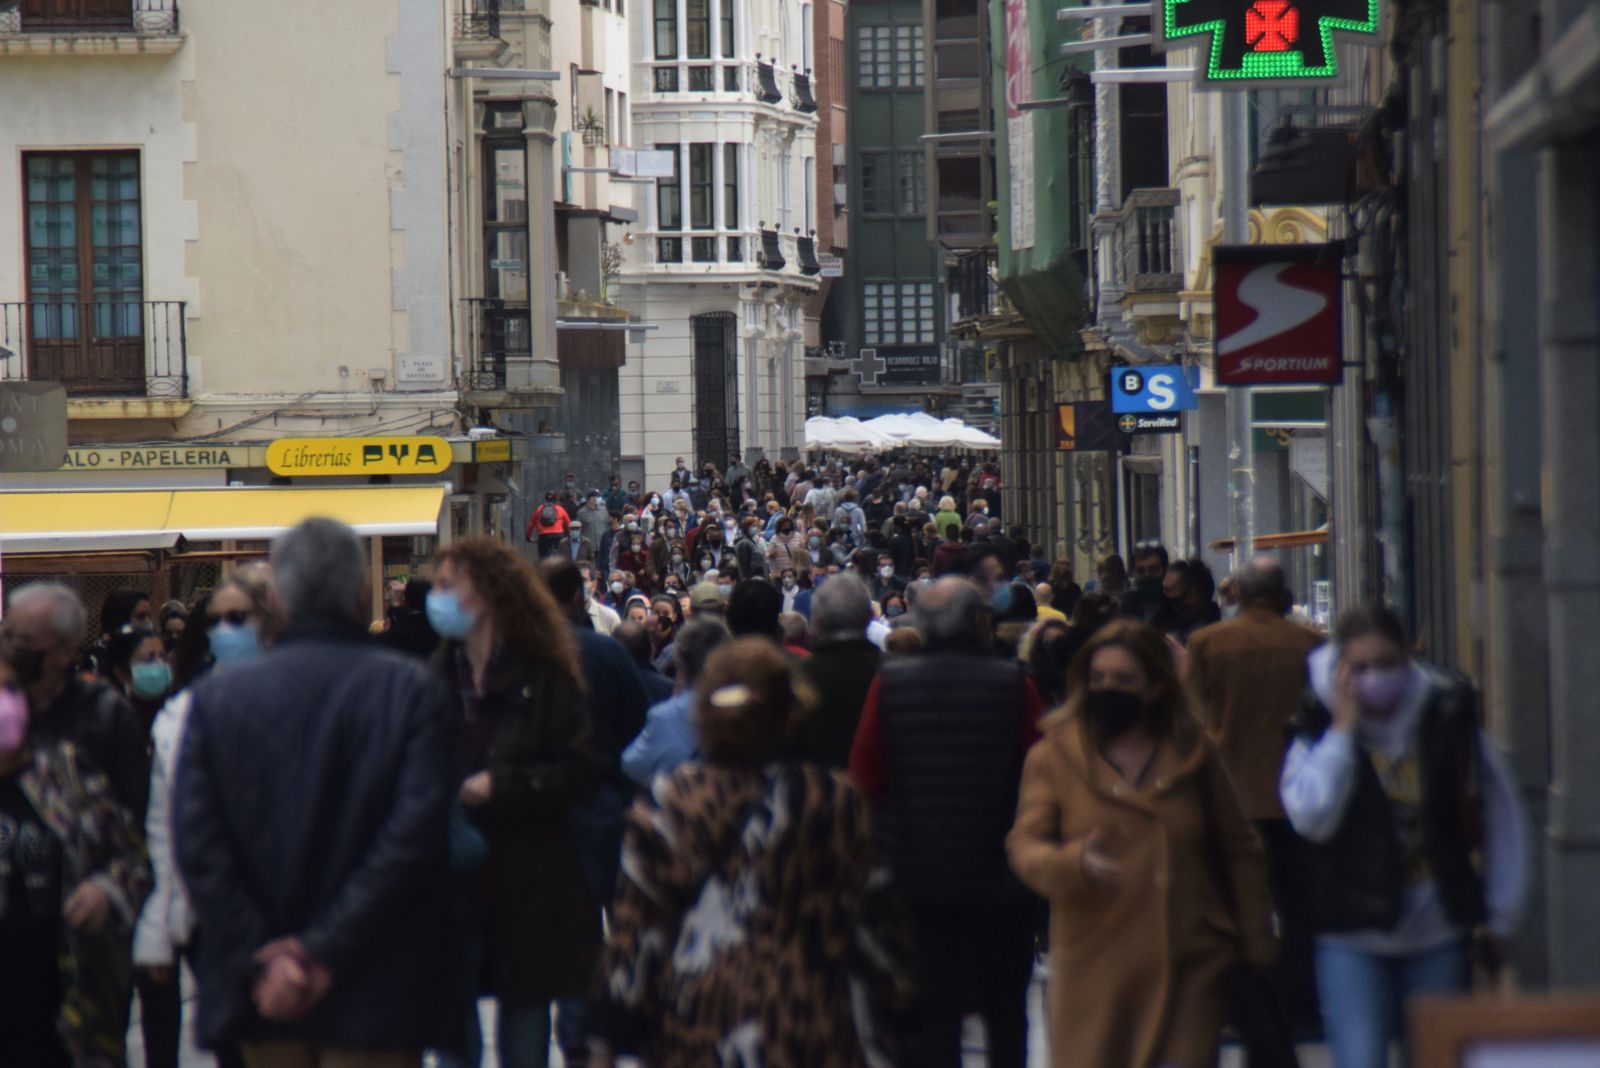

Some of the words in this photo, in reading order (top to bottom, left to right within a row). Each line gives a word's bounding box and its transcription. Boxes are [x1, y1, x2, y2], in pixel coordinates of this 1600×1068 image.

[1225, 357, 1328, 376] SPORTIUM
[1137, 417, 1177, 428] ServiRed
[120, 450, 231, 467] PAPELERIA
[280, 445, 352, 468] Librerías
[362, 444, 438, 467] PYA
